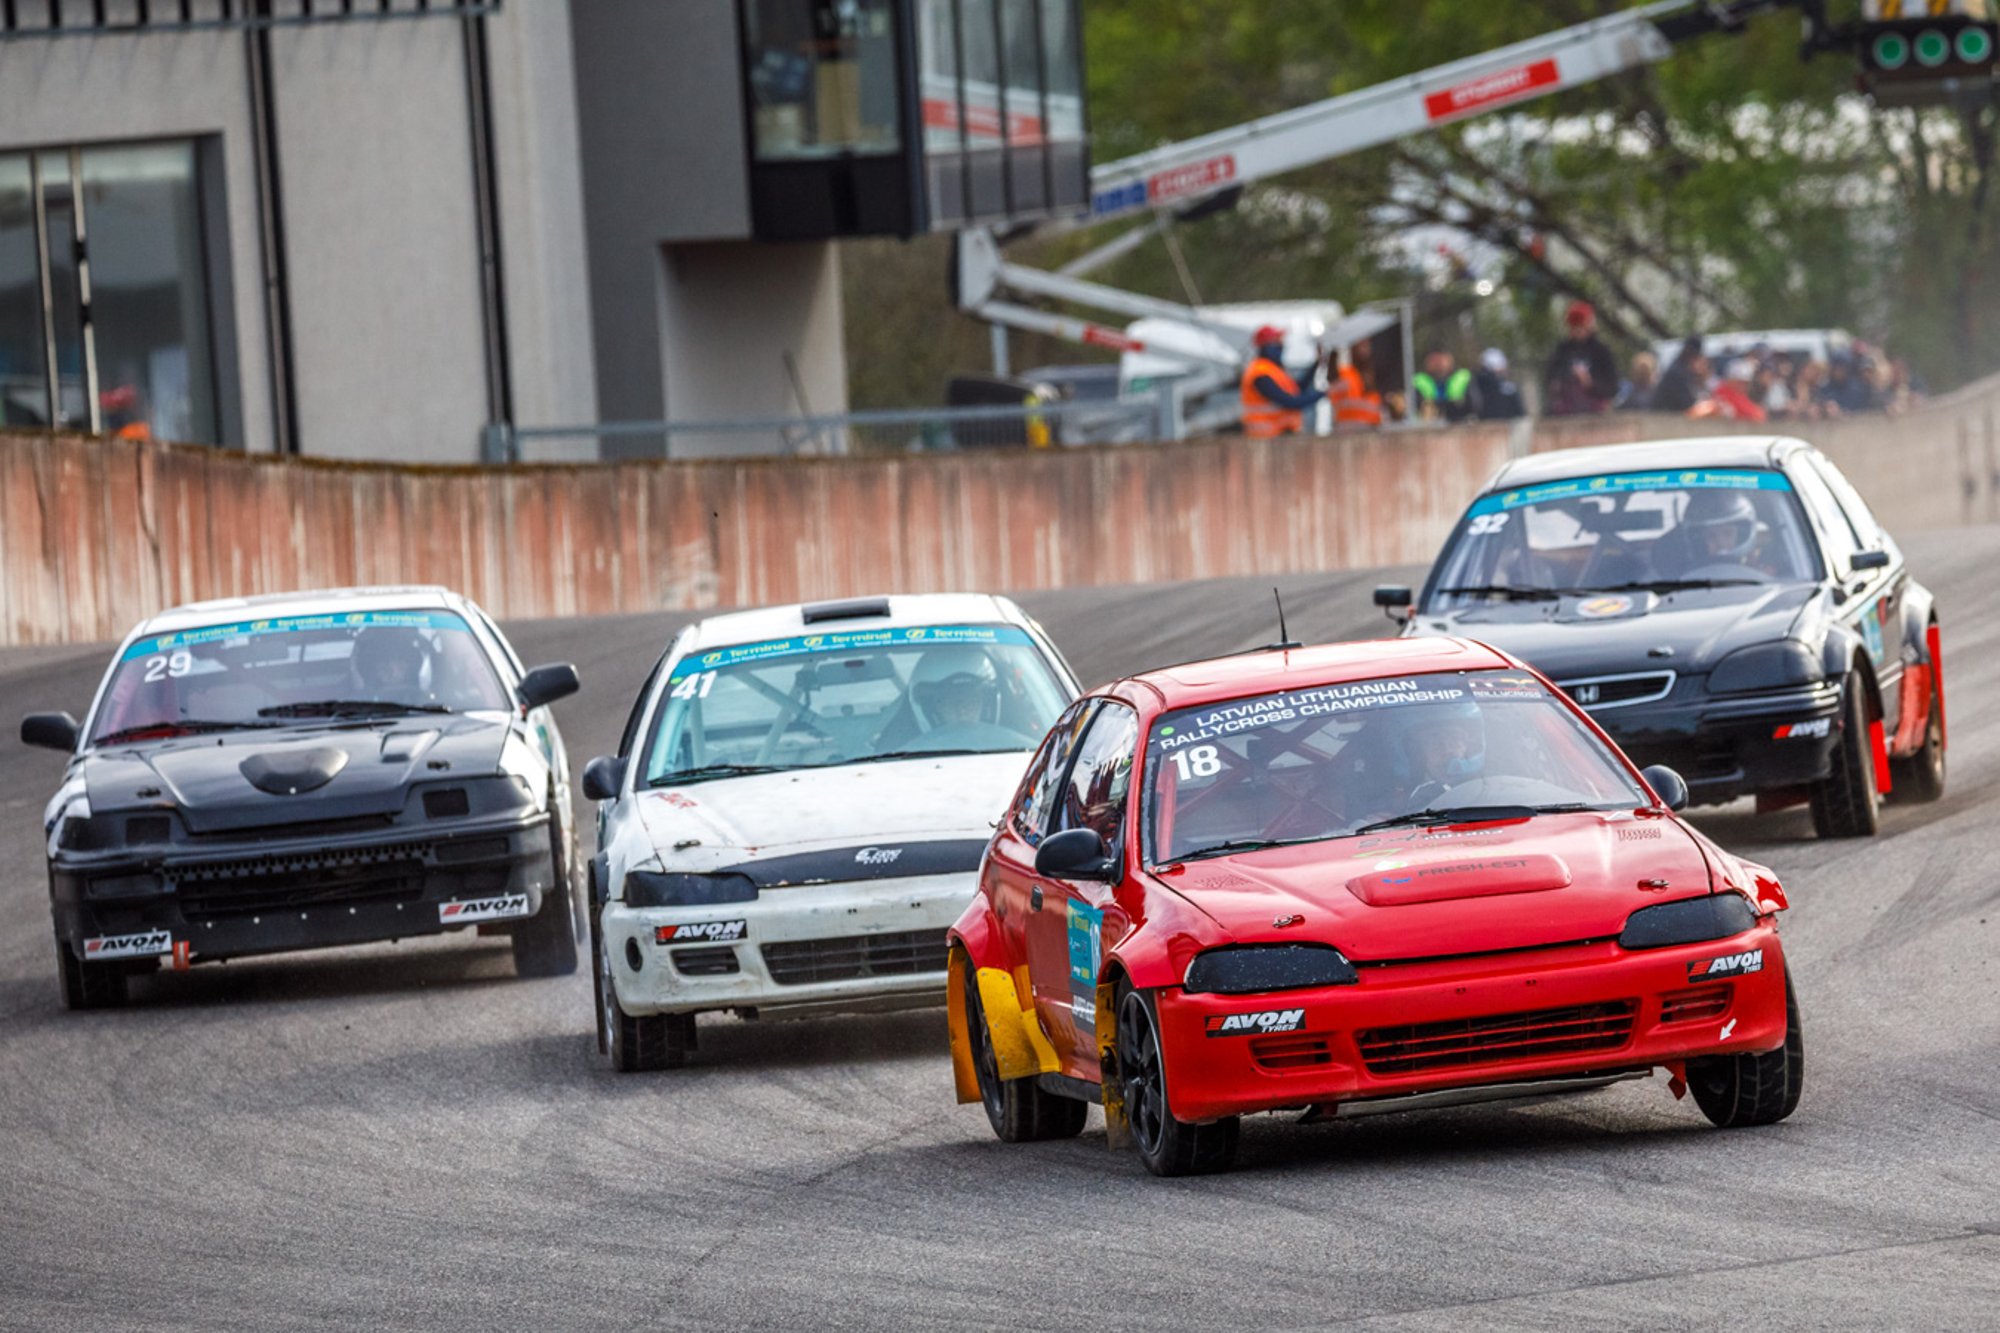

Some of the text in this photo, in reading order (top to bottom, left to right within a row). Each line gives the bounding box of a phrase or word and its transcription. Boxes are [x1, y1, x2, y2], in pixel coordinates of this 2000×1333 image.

[1468, 512, 1509, 535] 32
[183, 625, 238, 641] Terminal
[277, 615, 333, 627] Terminal
[730, 642, 790, 658] Terminal
[831, 631, 892, 643] Terminal
[933, 628, 995, 638] Terminal
[144, 651, 192, 683] 29
[670, 670, 717, 700] 41
[1196, 680, 1418, 727] LATVIAN LITHUANIAN
[1160, 689, 1464, 750] RALLYCROSS CHAMPIONSHIP
[1169, 745, 1221, 781] 18
[462, 898, 525, 914] AVON
[102, 934, 168, 951] AVON
[673, 921, 745, 939] AVON
[1708, 949, 1762, 974] AVON
[1222, 1009, 1305, 1031] AVON
[1262, 1023, 1297, 1033] TYRES
